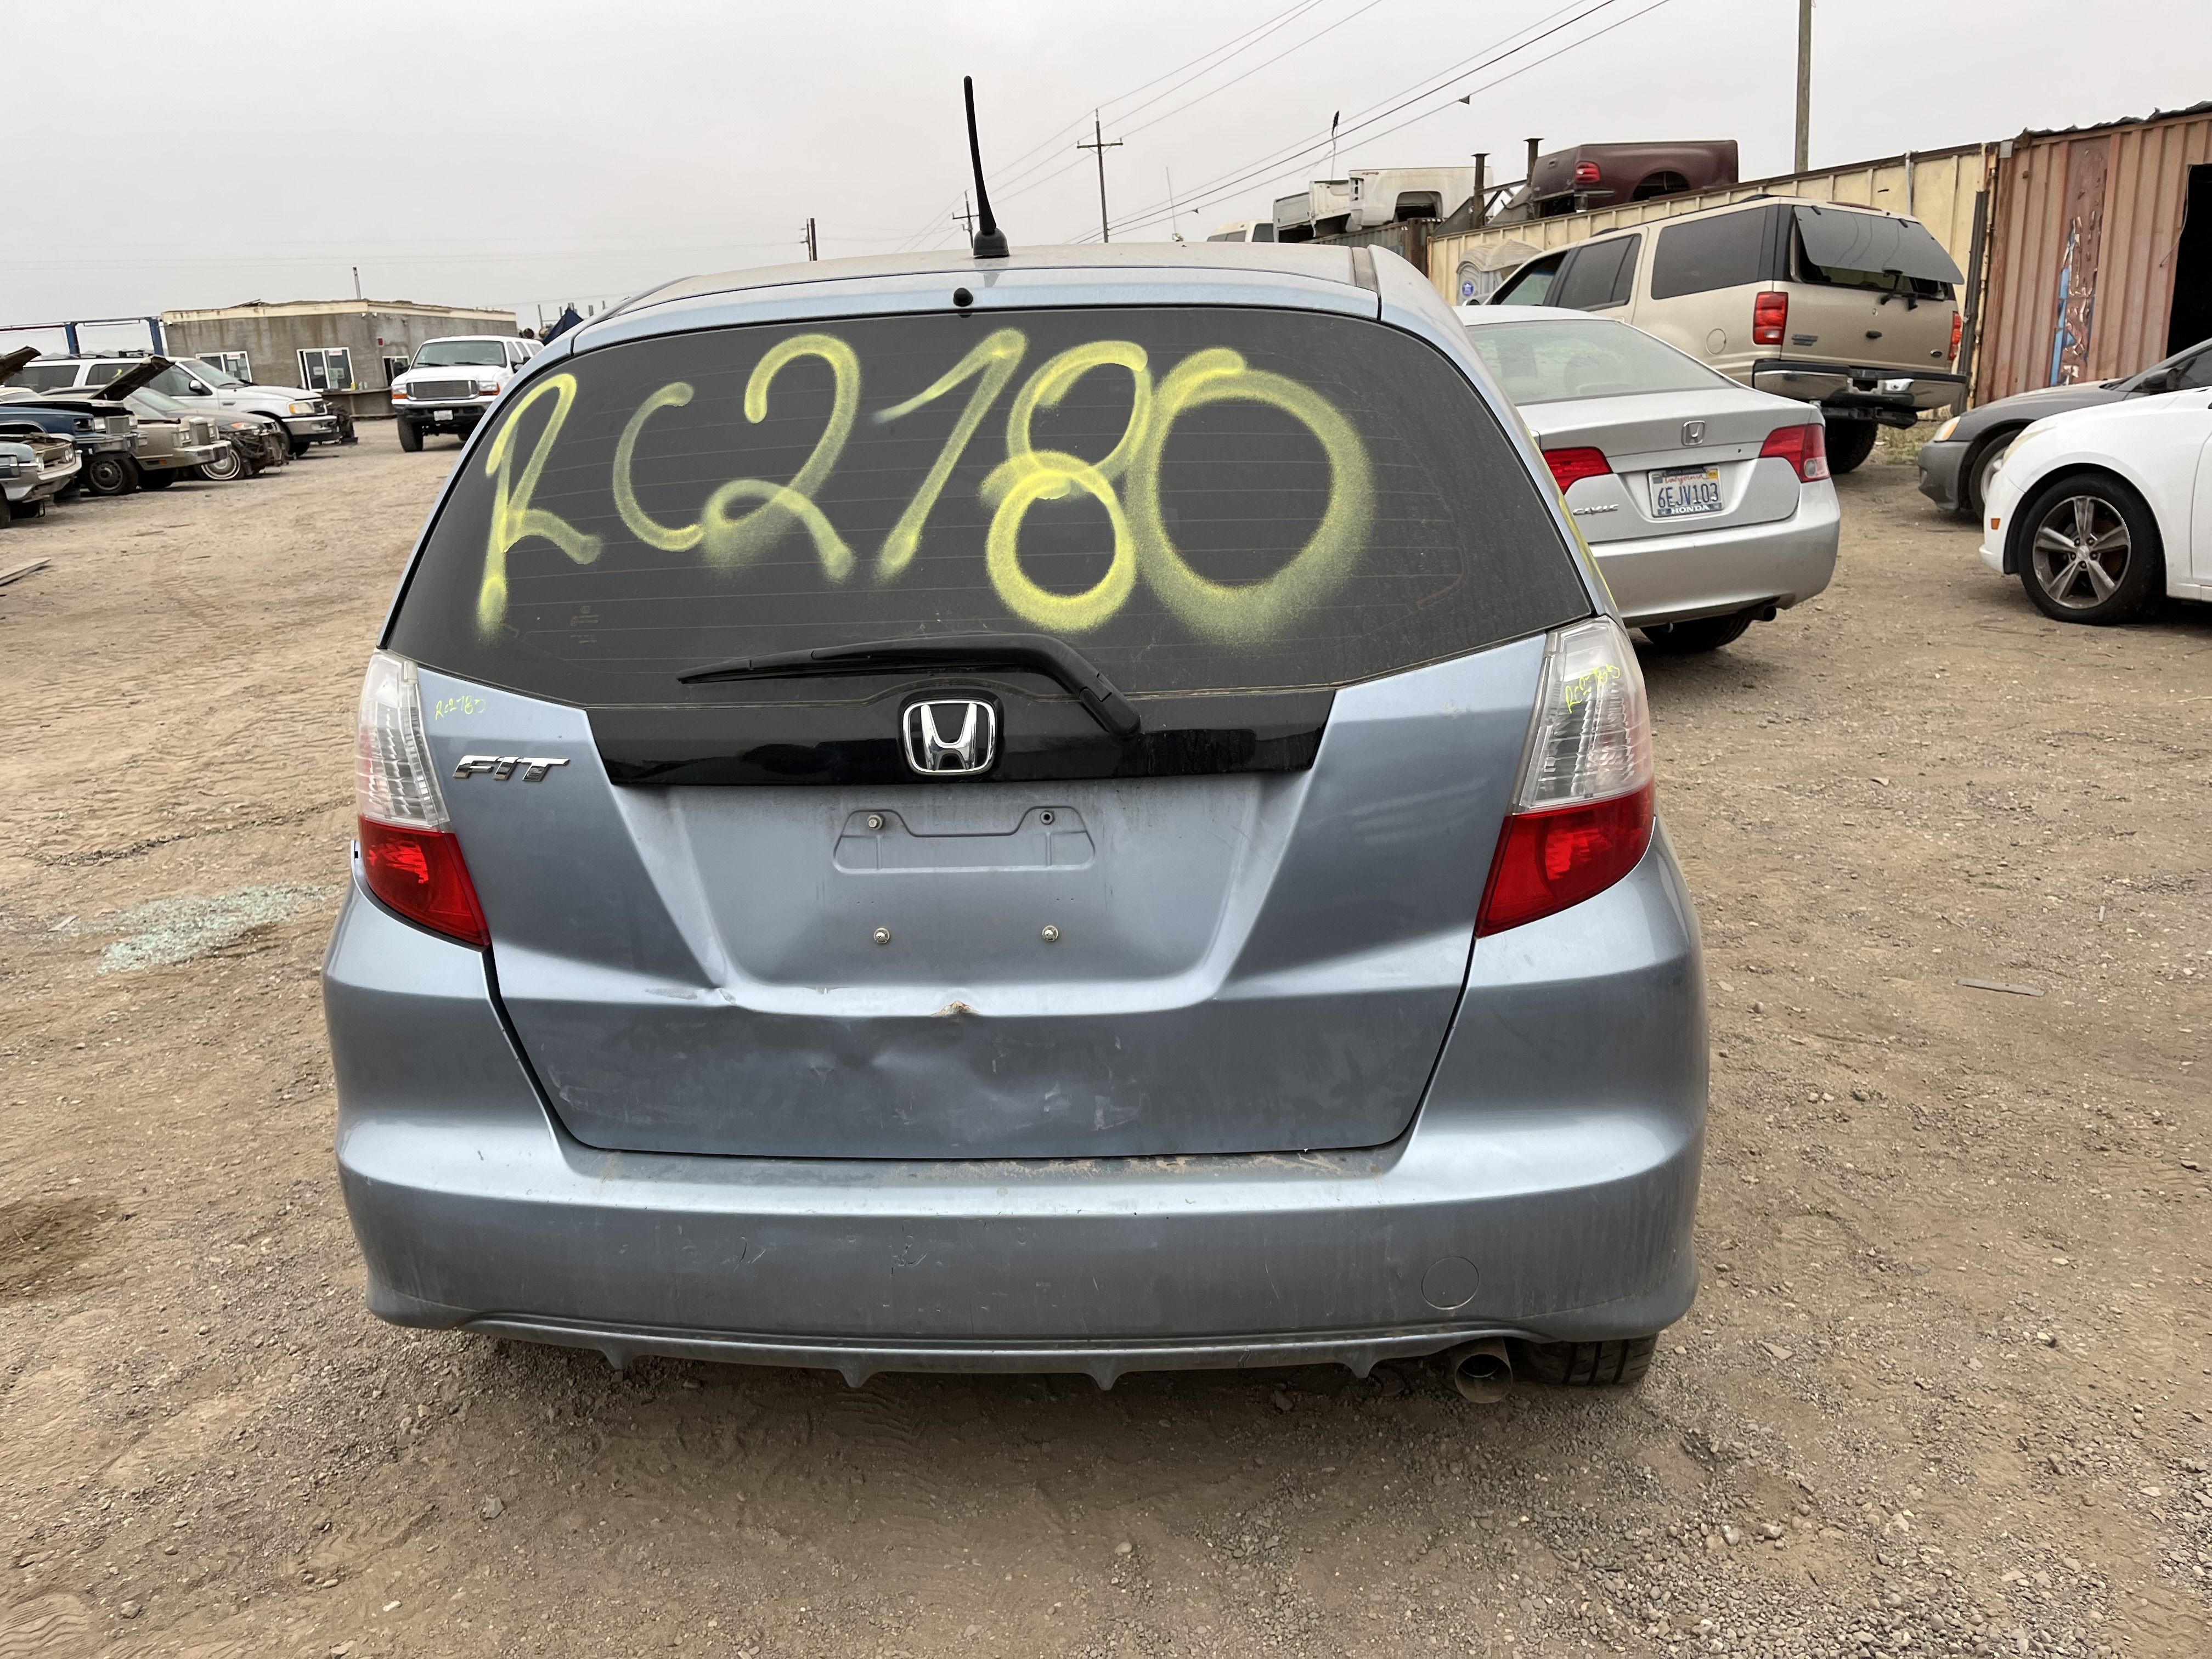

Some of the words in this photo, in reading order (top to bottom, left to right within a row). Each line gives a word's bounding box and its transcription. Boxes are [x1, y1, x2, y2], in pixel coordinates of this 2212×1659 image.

[1658, 482, 1719, 507] 6EJV103
[1671, 505, 1710, 514] HONDA
[452, 754, 570, 782] FIT
